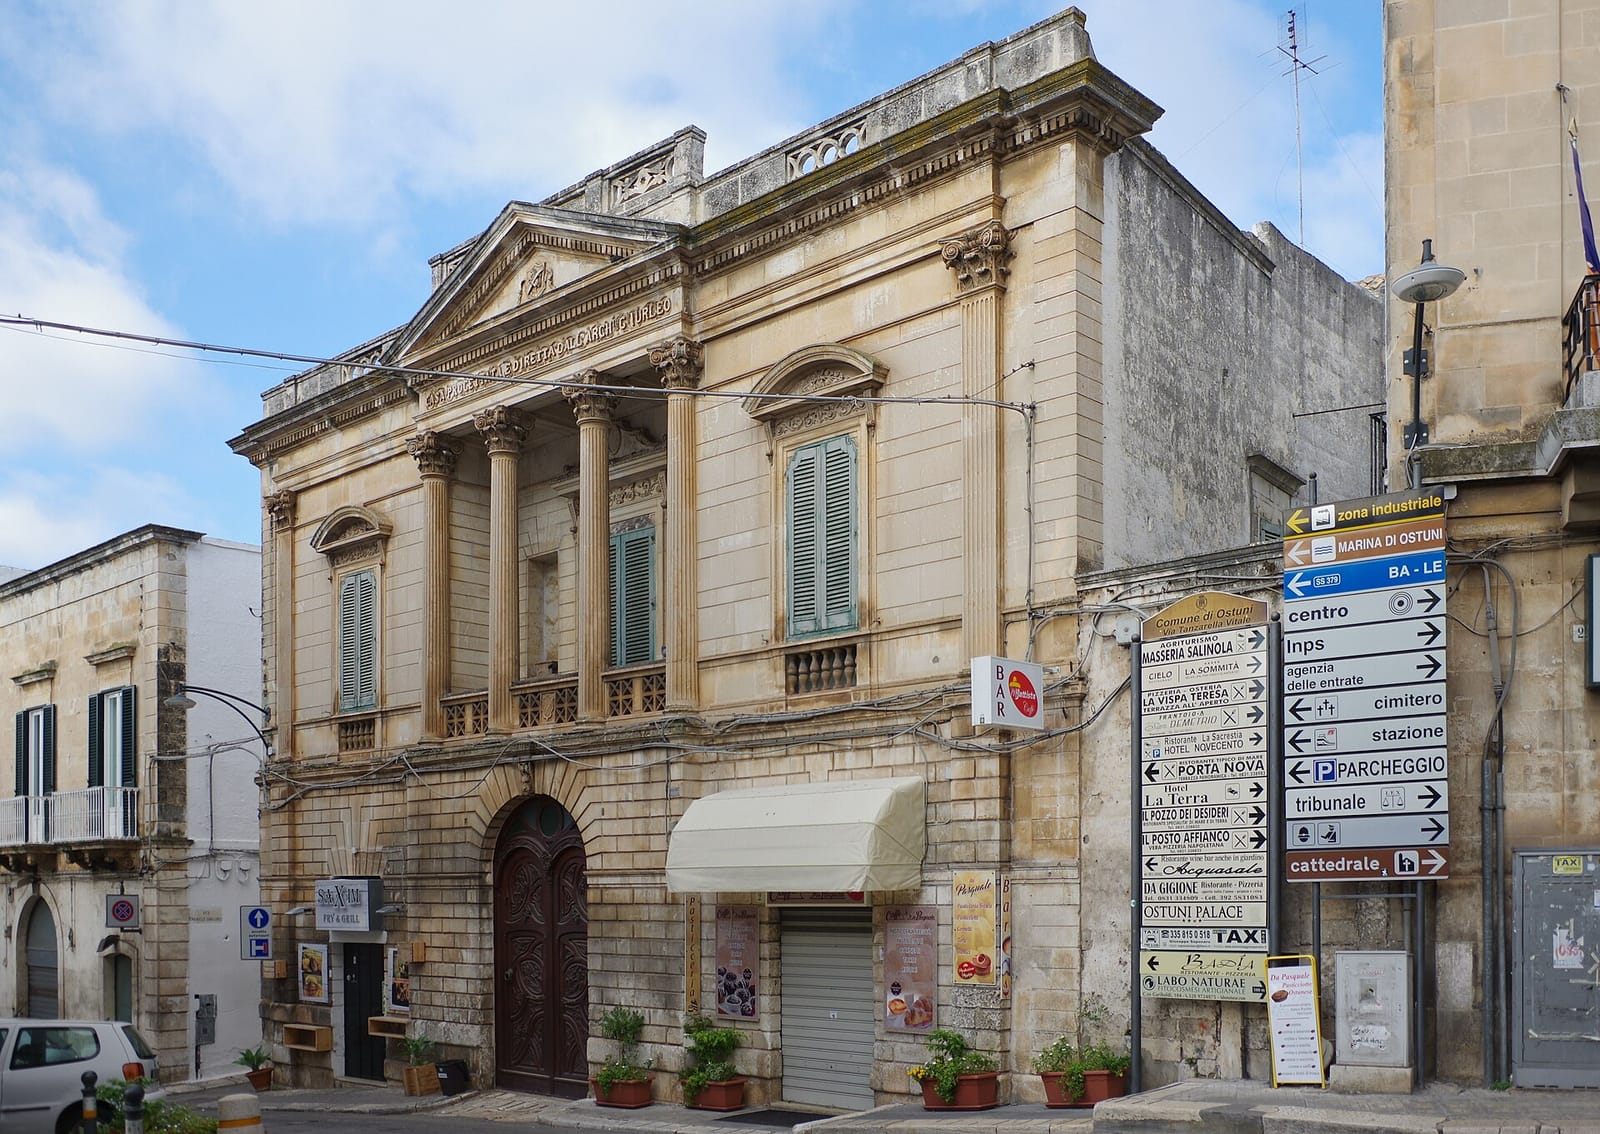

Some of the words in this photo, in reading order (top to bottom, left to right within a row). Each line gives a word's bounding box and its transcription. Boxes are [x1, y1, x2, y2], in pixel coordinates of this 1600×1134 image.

[1338, 505, 1368, 522] zona
[1372, 496, 1442, 517] industriale
[1338, 537, 1382, 553] MARINA
[1386, 534, 1397, 546] DI
[1400, 528, 1443, 544] OSTUNI
[1389, 566, 1410, 579] BA
[1424, 560, 1443, 574] LE
[1316, 576, 1326, 586] SS
[1326, 575, 1339, 585] 379
[1156, 615, 1200, 629] Comune
[1203, 611, 1213, 621] di
[1216, 605, 1254, 618] Ostuni
[1289, 606, 1349, 623] centro
[1162, 628, 1176, 636] Via
[1178, 621, 1223, 634] Tanzarella
[1226, 617, 1251, 627] Vitale
[1160, 636, 1219, 649] AGRITURISMO
[1287, 639, 1325, 656] Inps
[1142, 648, 1185, 665] MASSERIA
[1188, 641, 1233, 658] SALINOLA
[1148, 671, 1173, 681] CIELO
[1185, 667, 1195, 676] LA
[1198, 662, 1240, 675] SOMMITÀ
[1288, 663, 1334, 678] agenzia
[996, 665, 1006, 717] BAR
[1148, 689, 1181, 697] PIZZERIA
[1189, 684, 1222, 692] OSTERIA
[1288, 680, 1317, 691] delle
[1320, 676, 1364, 688] entrate
[1143, 698, 1155, 707] LA
[1158, 694, 1188, 705] VISPA
[1191, 689, 1229, 701] TERESA
[1374, 694, 1443, 710] cimitero
[1144, 705, 1180, 713] TERRAZZA
[1200, 699, 1229, 707] APERTO
[1165, 736, 1197, 746] Ristorante
[1202, 734, 1210, 742] La
[1212, 731, 1243, 741] Sacrestia
[1372, 726, 1444, 742] stazione
[1165, 745, 1190, 755] HOTEL
[1194, 740, 1244, 753] NOVECENTO
[1179, 764, 1220, 777] PORTA
[1225, 760, 1265, 773] NOVA
[1338, 756, 1445, 778] PARCHEGGIO
[1164, 784, 1188, 793] Hotel
[1146, 795, 1163, 807] La
[1168, 793, 1208, 805] Terra
[1296, 794, 1366, 812] tribunale
[1142, 811, 1149, 822] IL
[1151, 809, 1177, 821] POZZO
[1180, 808, 1192, 819] DEI
[1194, 807, 1229, 819] DESIDERI
[1142, 835, 1150, 845] IL
[1152, 833, 1181, 845] POSTO
[1184, 831, 1230, 843] AFFIANCO
[1163, 862, 1263, 879] Acquasale
[1290, 856, 1380, 873] cattedrale
[1144, 882, 1157, 894] DA
[1160, 881, 1199, 894] GIGIONE
[1238, 880, 1264, 888] Pizzeria
[324, 913, 335, 923] FRY
[342, 914, 361, 923] GRILL
[1144, 906, 1192, 919] OSTUNI
[1196, 906, 1243, 919] PALACE
[1170, 930, 1181, 939] 335
[1182, 930, 1193, 939] 815
[1200, 930, 1210, 939] 518
[1213, 930, 1267, 944] TAXI
[1158, 976, 1187, 986] LABO
[1192, 977, 1246, 988] NATURAE
[1282, 971, 1310, 981] Pasquale
